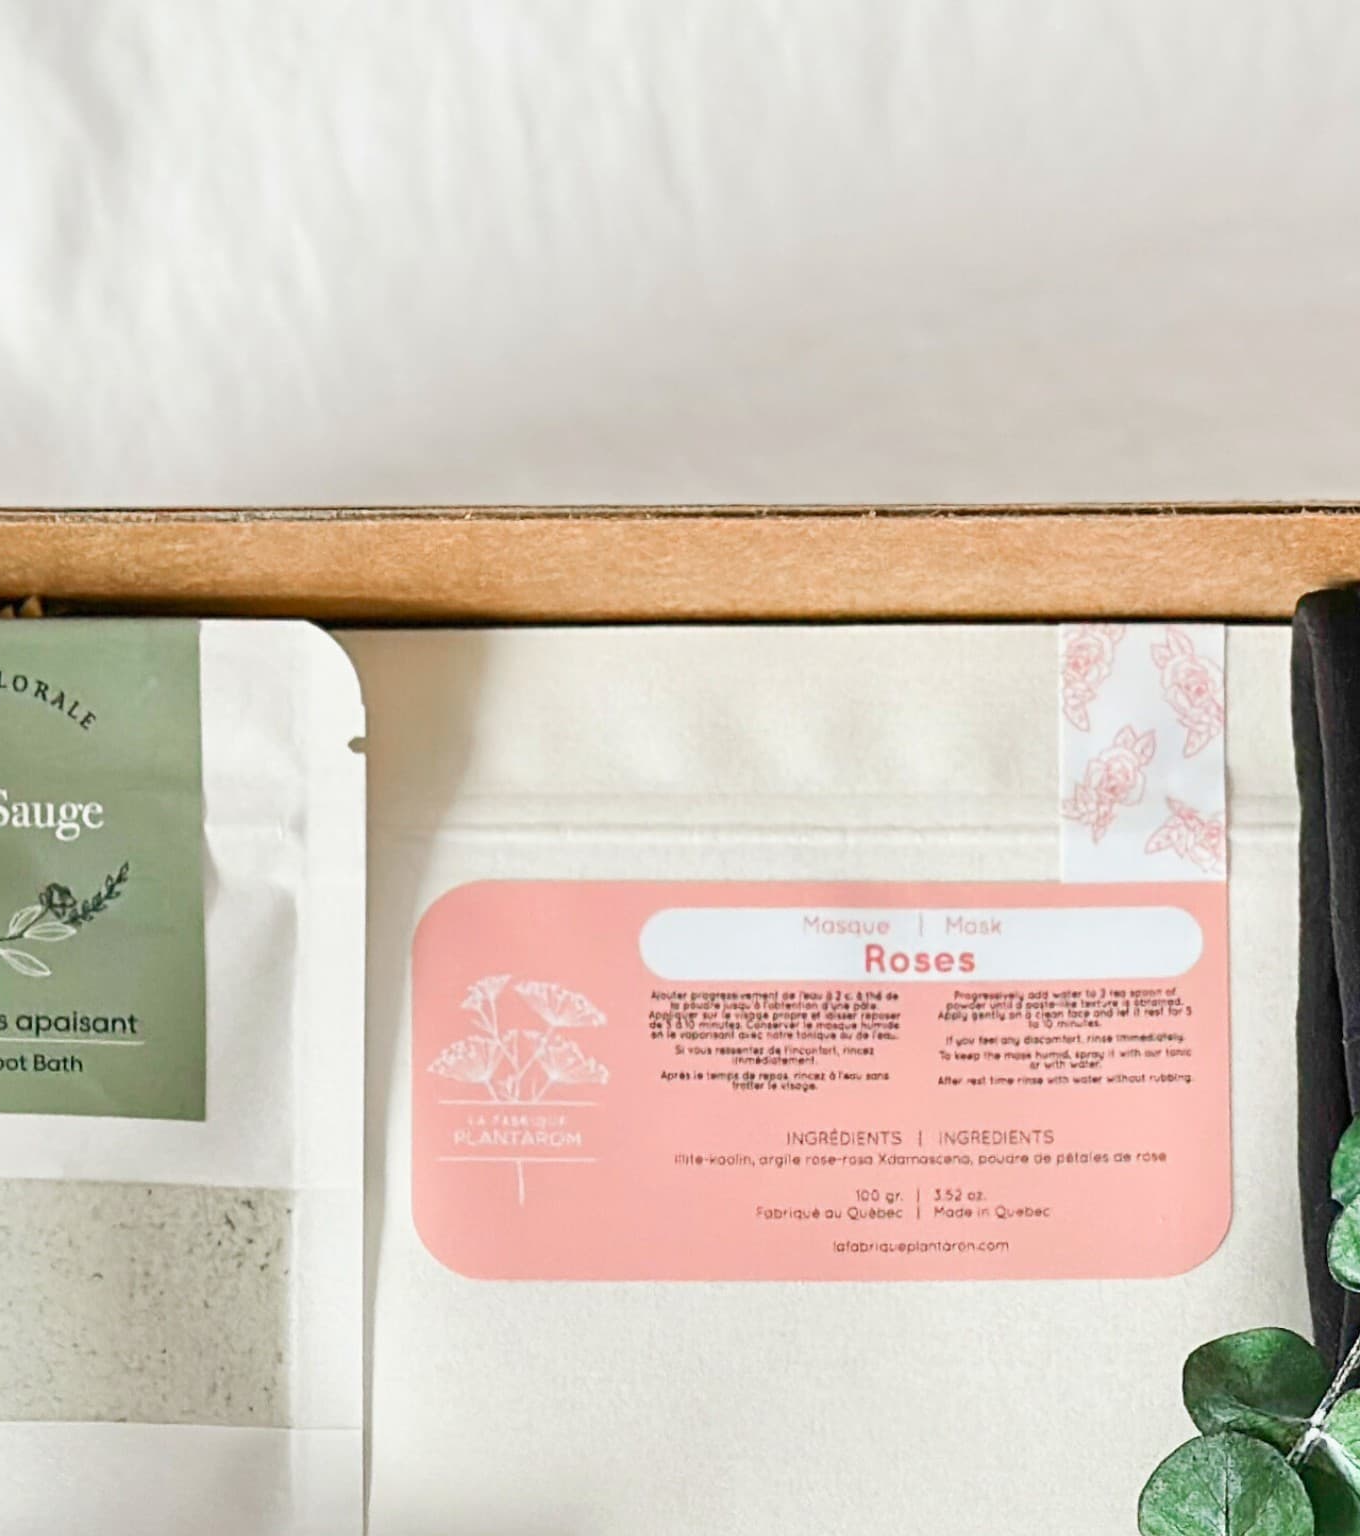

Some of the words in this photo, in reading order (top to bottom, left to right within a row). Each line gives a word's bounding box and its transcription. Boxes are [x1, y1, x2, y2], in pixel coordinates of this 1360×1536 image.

[802, 915, 891, 937] Masque
[945, 915, 1002, 935] Mask
[864, 943, 975, 973] Roses
[15, 1010, 137, 1037] apaisant
[33, 1054, 83, 1073] Bath
[453, 1129, 582, 1145] PLANTAROM
[786, 1129, 902, 1146] INGRÉDIENTS
[939, 1130, 1054, 1144] INGREDIENTS
[759, 1154, 801, 1168] argile
[805, 1154, 872, 1165] rose-rosa
[978, 1152, 1029, 1165] poudre
[1033, 1152, 1051, 1164] de
[1056, 1152, 1109, 1165] pétales
[1114, 1152, 1131, 1162] de
[1136, 1152, 1166, 1162] rose
[855, 1189, 880, 1201] 100
[886, 1190, 903, 1204] gr.
[755, 1206, 820, 1220] Fabriqué
[825, 1209, 841, 1219] au
[846, 1206, 903, 1220] Québec
[934, 1206, 972, 1218] Made
[977, 1207, 989, 1217] in
[995, 1205, 1050, 1219] Quebec
